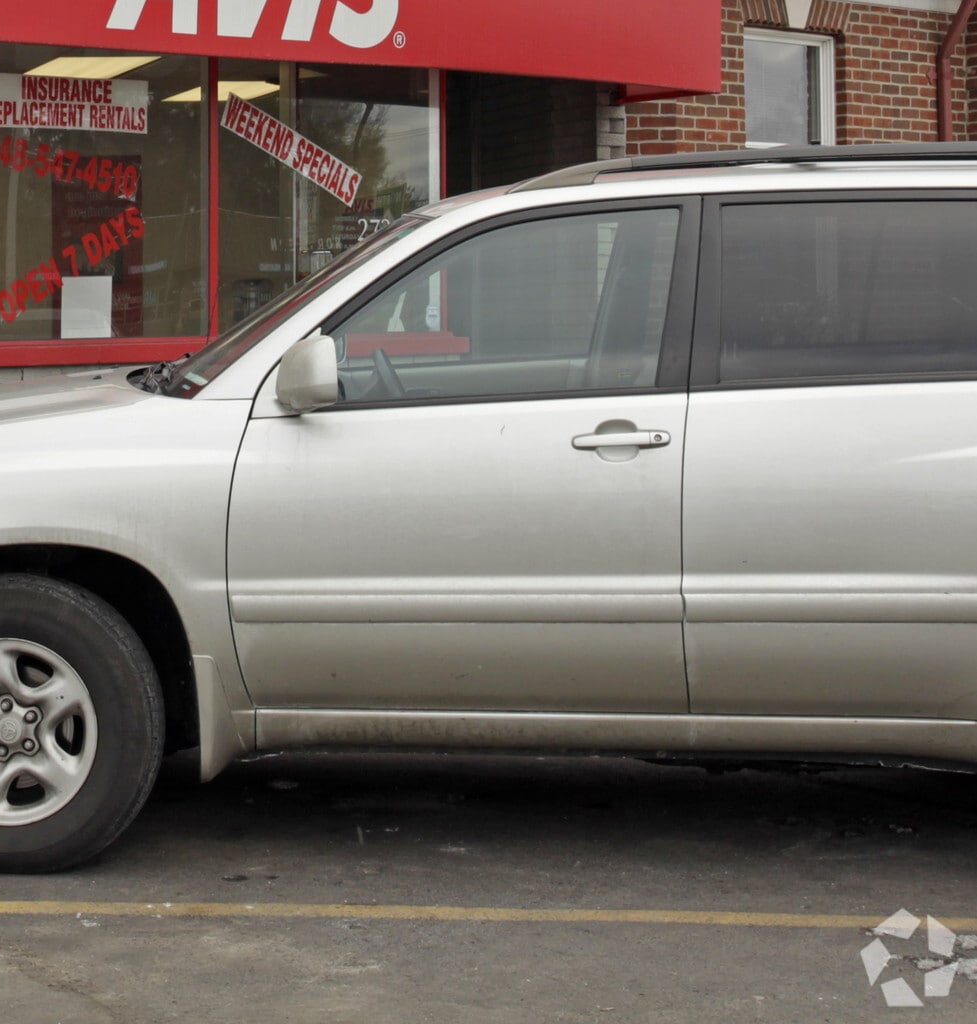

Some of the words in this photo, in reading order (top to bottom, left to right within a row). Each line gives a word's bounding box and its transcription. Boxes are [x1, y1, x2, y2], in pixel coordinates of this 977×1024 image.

[21, 76, 112, 103] INSURANCE
[89, 105, 146, 131] RENTALS
[224, 95, 293, 159] WEEKEND
[292, 138, 359, 203] SPECIALS
[62, 245, 80, 277] 7
[81, 206, 145, 266] DAYS
